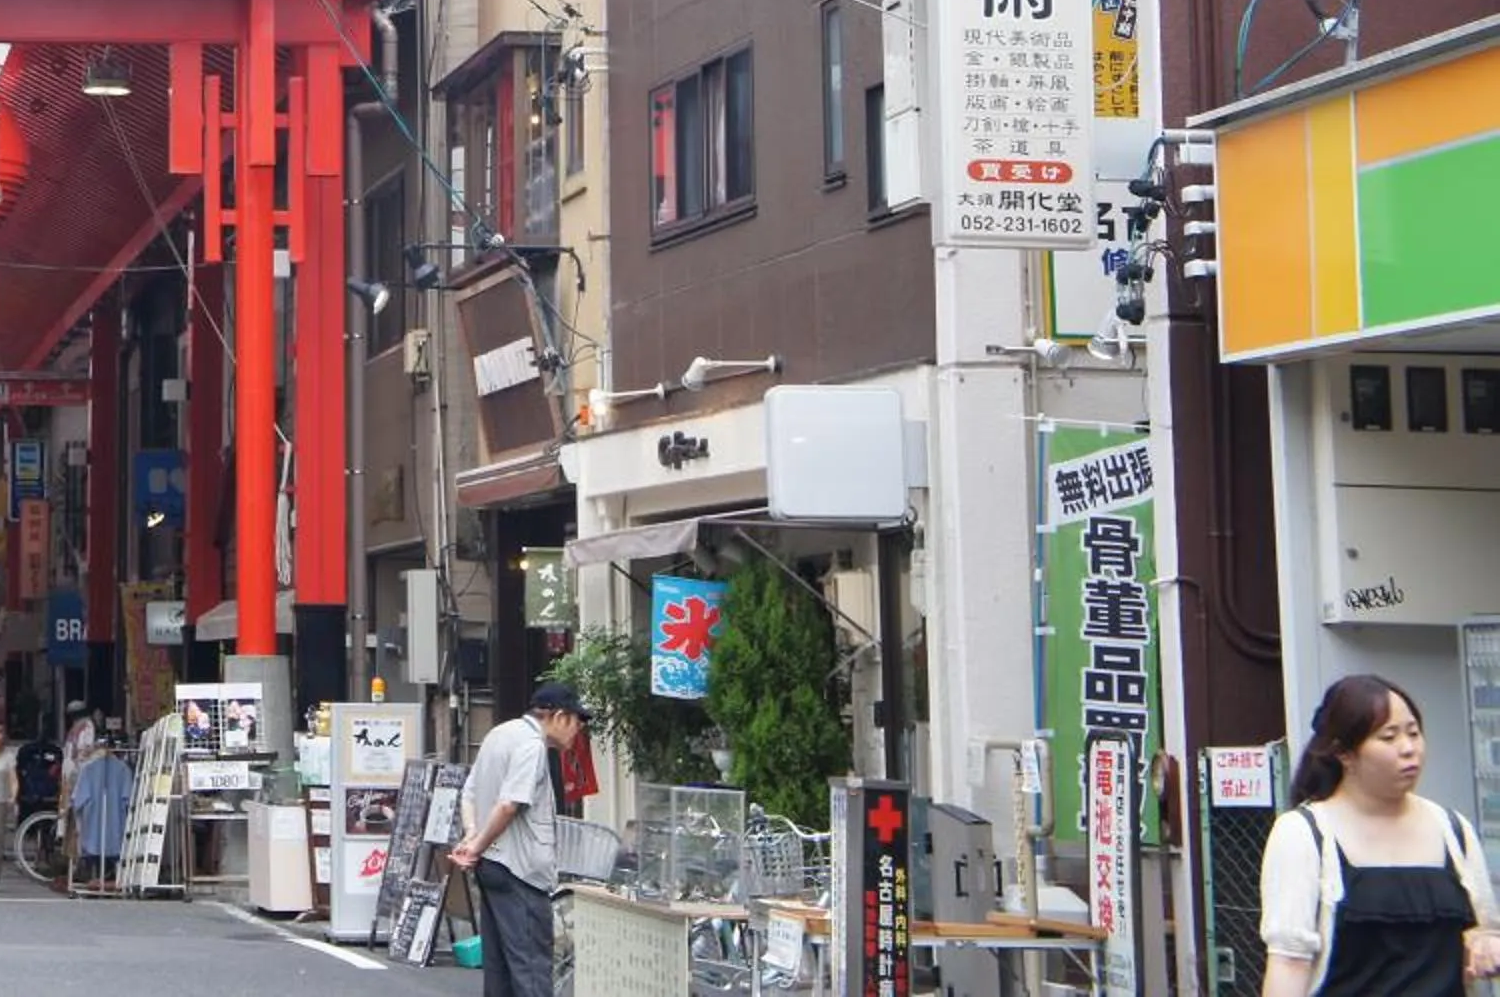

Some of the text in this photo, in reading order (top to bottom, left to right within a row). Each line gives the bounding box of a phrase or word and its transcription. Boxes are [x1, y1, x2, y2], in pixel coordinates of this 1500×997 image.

[960, 214, 1083, 234] 052-231-1602
[998, 191, 1083, 214] 開化堂
[1055, 446, 1153, 516] 無料出張
[660, 597, 722, 660] 氷
[1082, 516, 1148, 829] 骨董品
